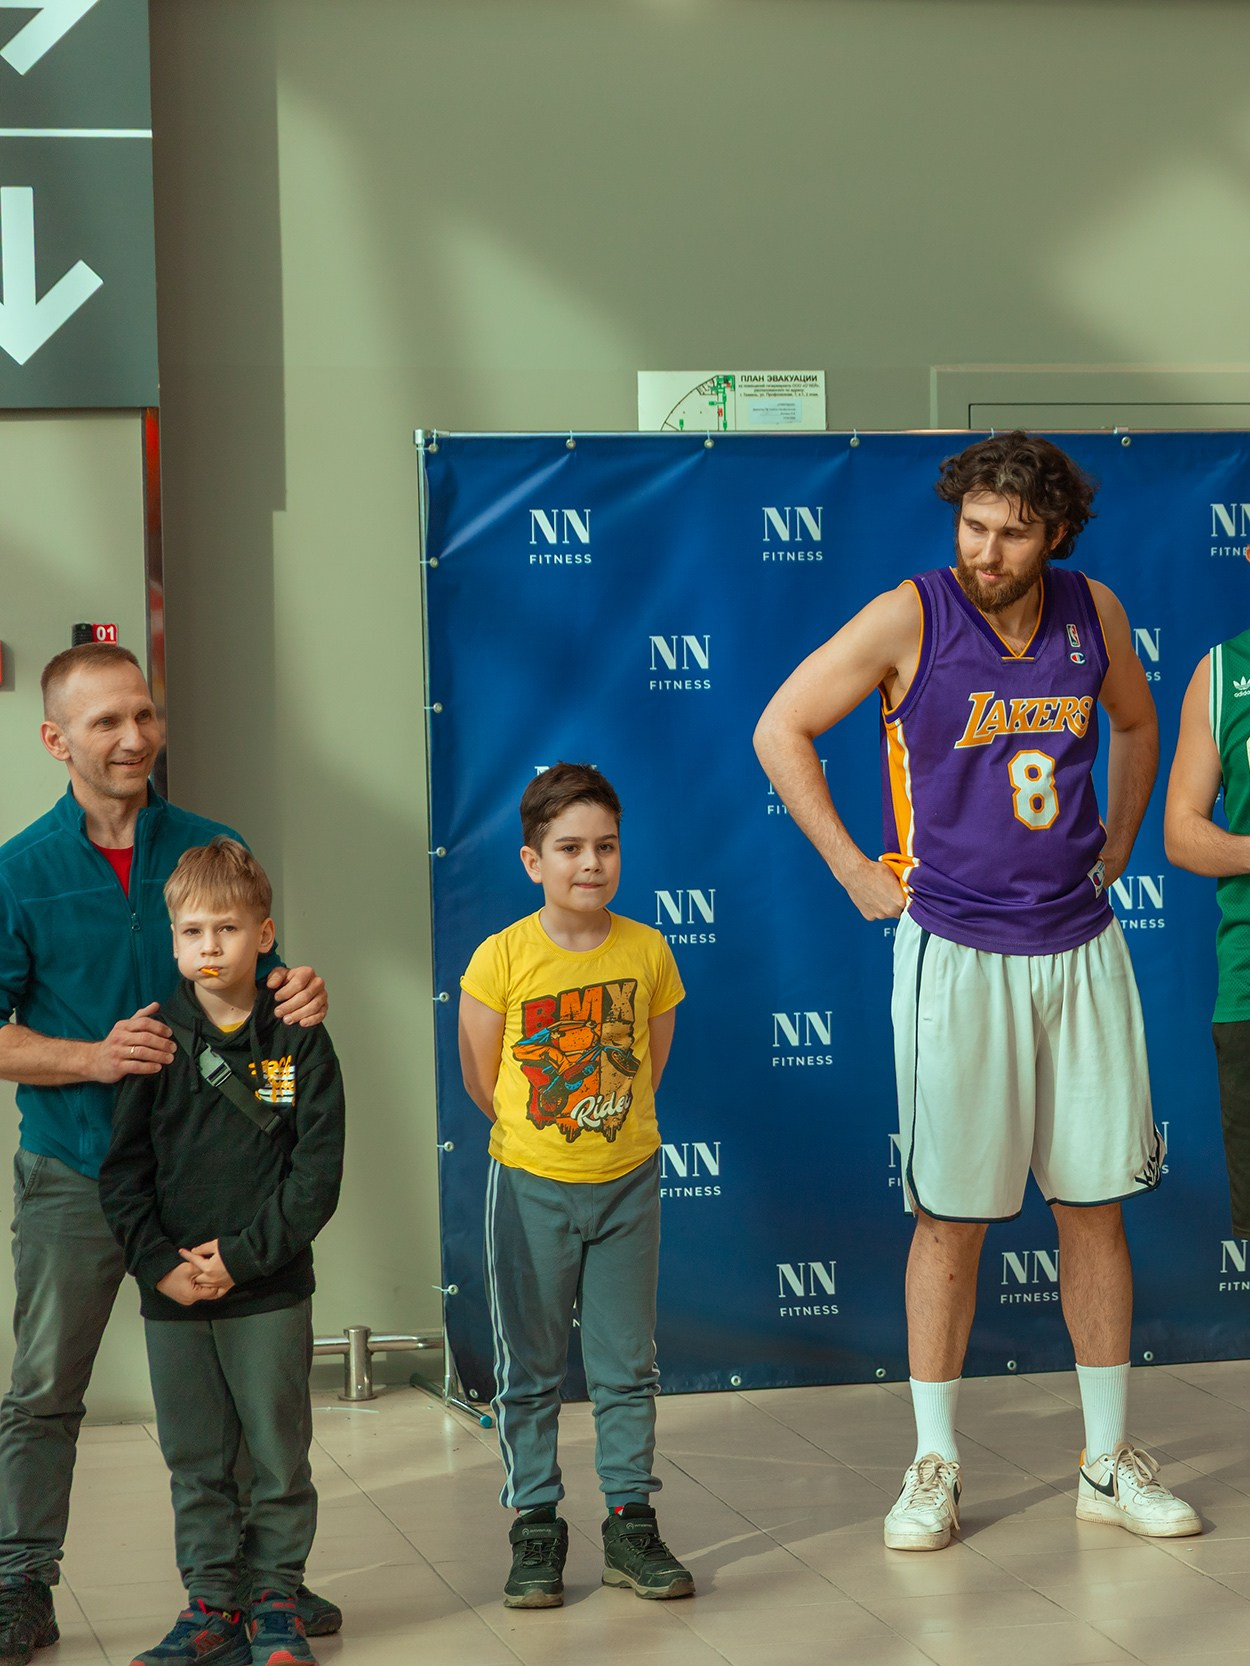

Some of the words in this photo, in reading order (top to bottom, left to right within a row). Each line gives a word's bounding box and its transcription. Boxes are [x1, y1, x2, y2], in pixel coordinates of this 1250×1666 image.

[767, 375, 818, 383] ЭВАКУАЦИИ
[530, 509, 591, 544] NN
[762, 507, 823, 542] NN
[530, 554, 592, 564] FITNESS
[763, 551, 823, 561] FITNESS
[1211, 547, 1246, 556] FITN
[96, 626, 115, 641] 01
[1133, 628, 1161, 662] N
[649, 635, 710, 670] NN
[650, 680, 711, 690] FITNESS
[954, 691, 1093, 749] LAKERS
[1007, 749, 1060, 831] 8
[655, 889, 716, 925] NN
[1109, 875, 1165, 910] NN
[664, 933, 716, 944] ITNESS
[1121, 919, 1165, 929] TNESS
[524, 981, 637, 1040] BMX
[772, 1011, 833, 1047] NN
[772, 1055, 833, 1067] FITNESS
[660, 1142, 721, 1178] NN
[660, 1186, 721, 1198] FITNESS
[776, 1261, 837, 1298] NN
[1001, 1249, 1059, 1285] NN
[780, 1305, 839, 1317] FITNESS
[1001, 1292, 1059, 1304] FITNESS
